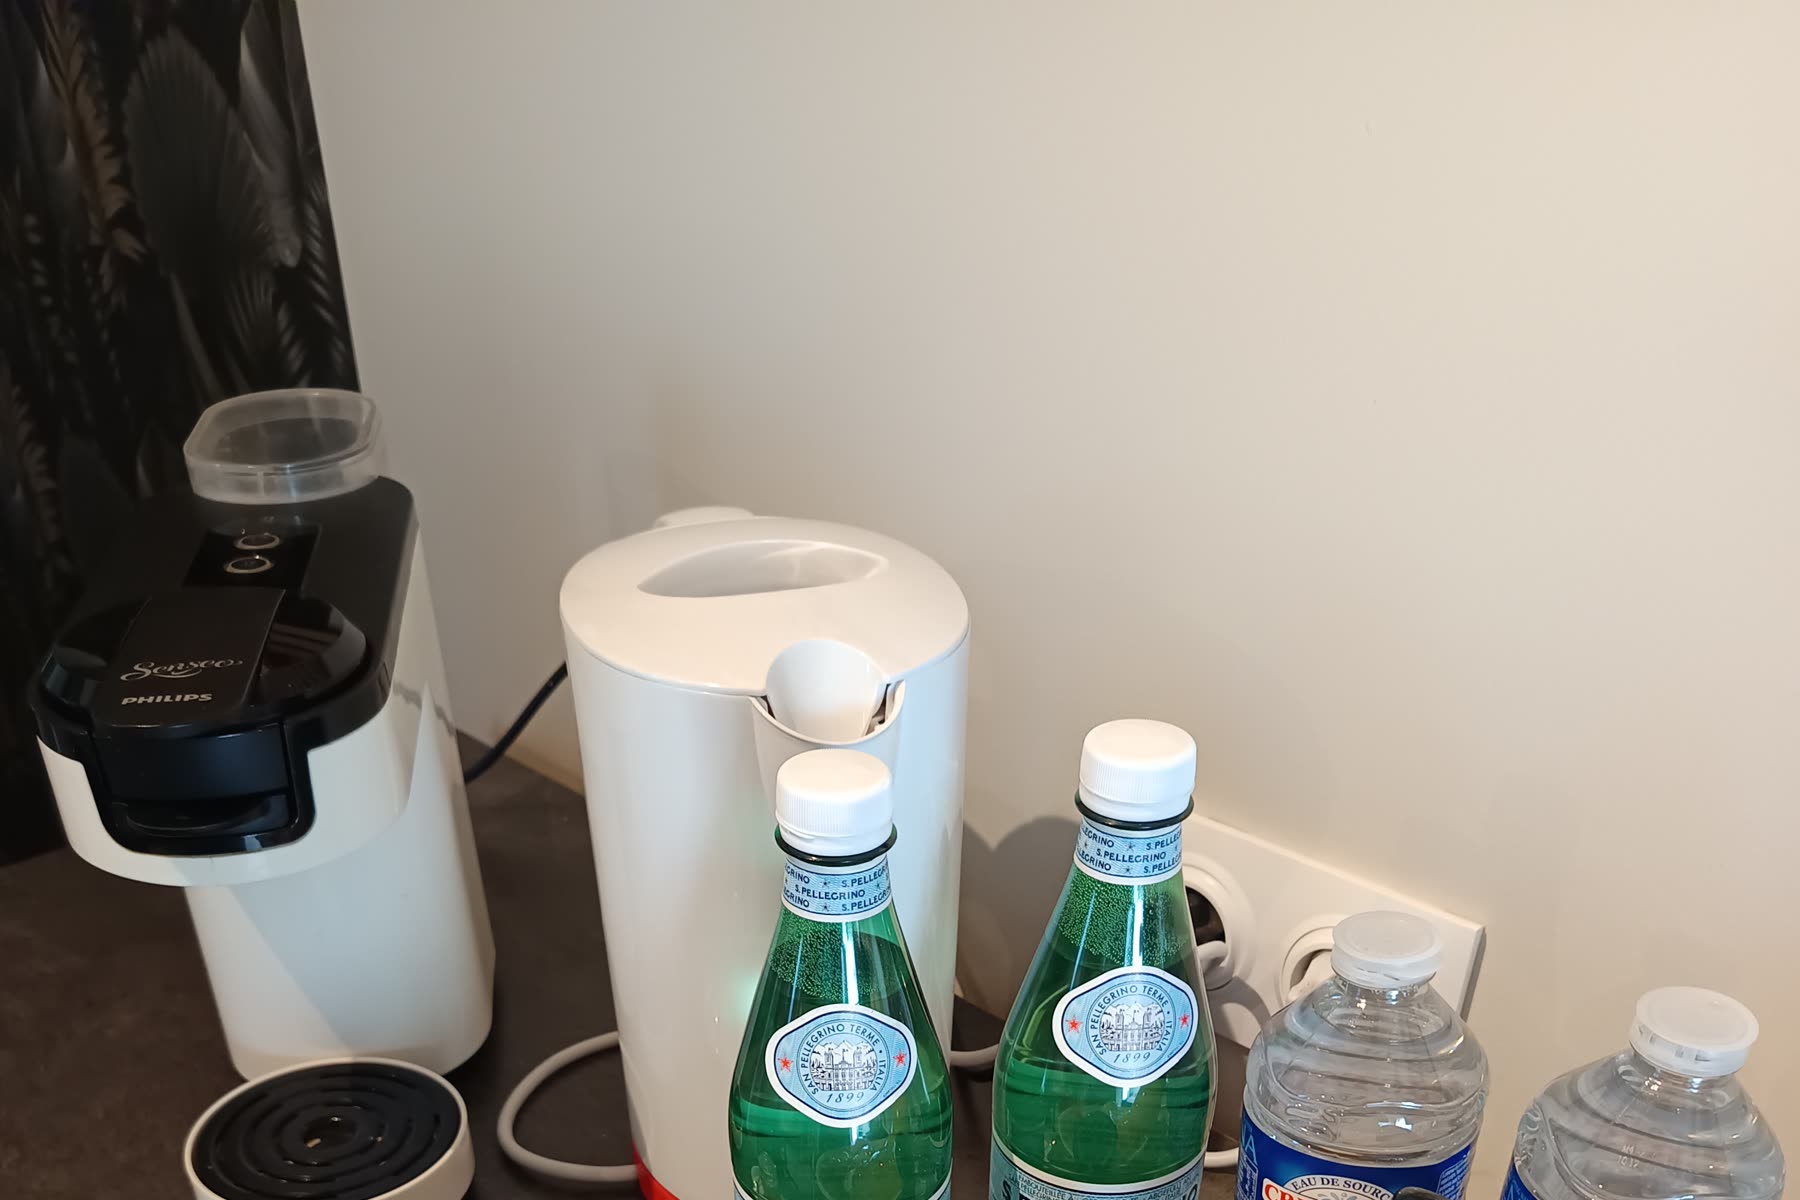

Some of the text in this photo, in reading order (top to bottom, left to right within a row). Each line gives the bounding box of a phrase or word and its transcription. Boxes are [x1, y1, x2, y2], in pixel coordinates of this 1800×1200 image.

[120, 659, 242, 680] Senseo
[121, 693, 212, 704] PHILIPS
[1090, 984, 1138, 1030] PELLEGRINO
[1142, 985, 1169, 1007] TERME
[801, 1023, 845, 1069] PELLEGRINO
[850, 1024, 880, 1046] TERME
[1091, 1034, 1107, 1056] SAN
[1156, 1020, 1172, 1052] ITALIA
[1113, 1051, 1151, 1064] 1899
[803, 1073, 819, 1095] SAN
[870, 1060, 886, 1092] ITALIA
[826, 1091, 865, 1104] 1899
[1291, 1177, 1317, 1191] EAU
[1320, 1177, 1340, 1187] DE
